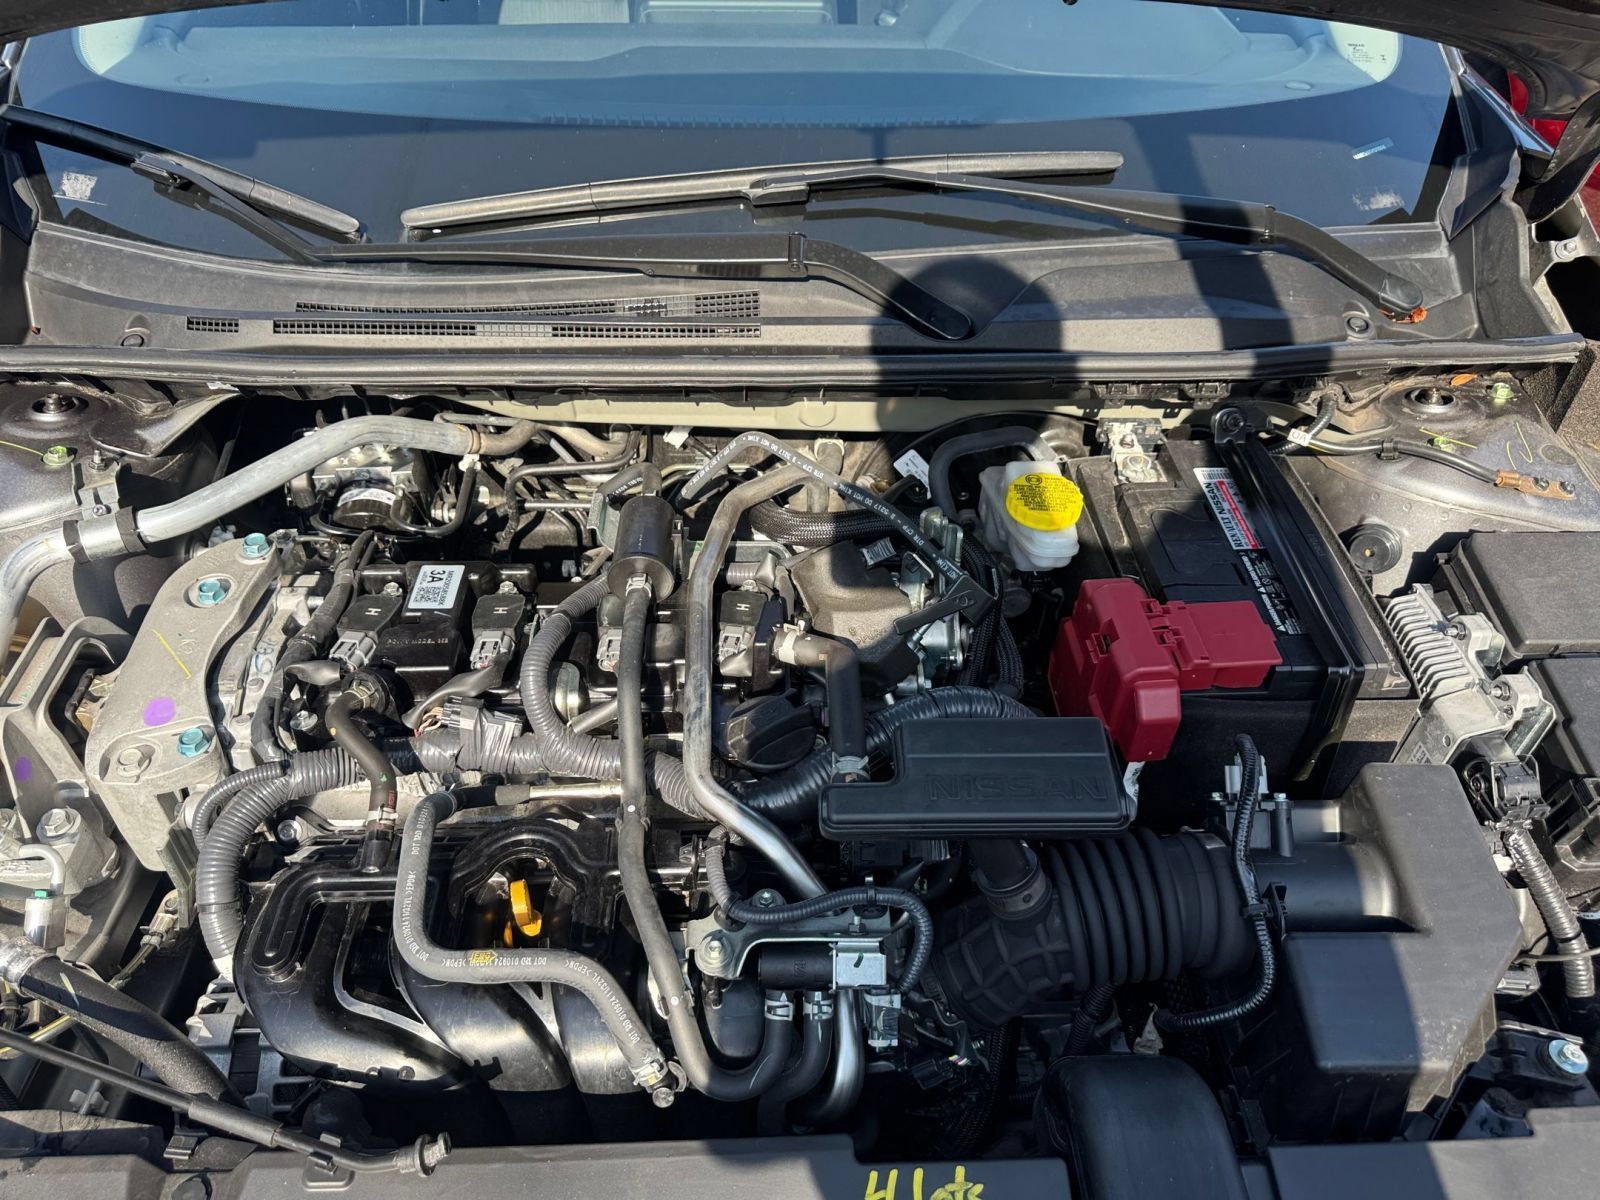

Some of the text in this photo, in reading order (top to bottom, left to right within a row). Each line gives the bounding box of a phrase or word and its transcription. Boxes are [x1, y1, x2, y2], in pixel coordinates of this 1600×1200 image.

[1203, 482, 1228, 515] NISSAN
[902, 525, 914, 536] CFP
[1221, 516, 1245, 548] RENAULT
[913, 535, 924, 546] DTR
[427, 570, 446, 584] 3A
[926, 773, 1108, 800] NISSAN
[411, 839, 420, 855] DOT
[417, 951, 429, 962] DOT
[534, 957, 547, 965] DOT
[628, 1031, 640, 1044] DOT
